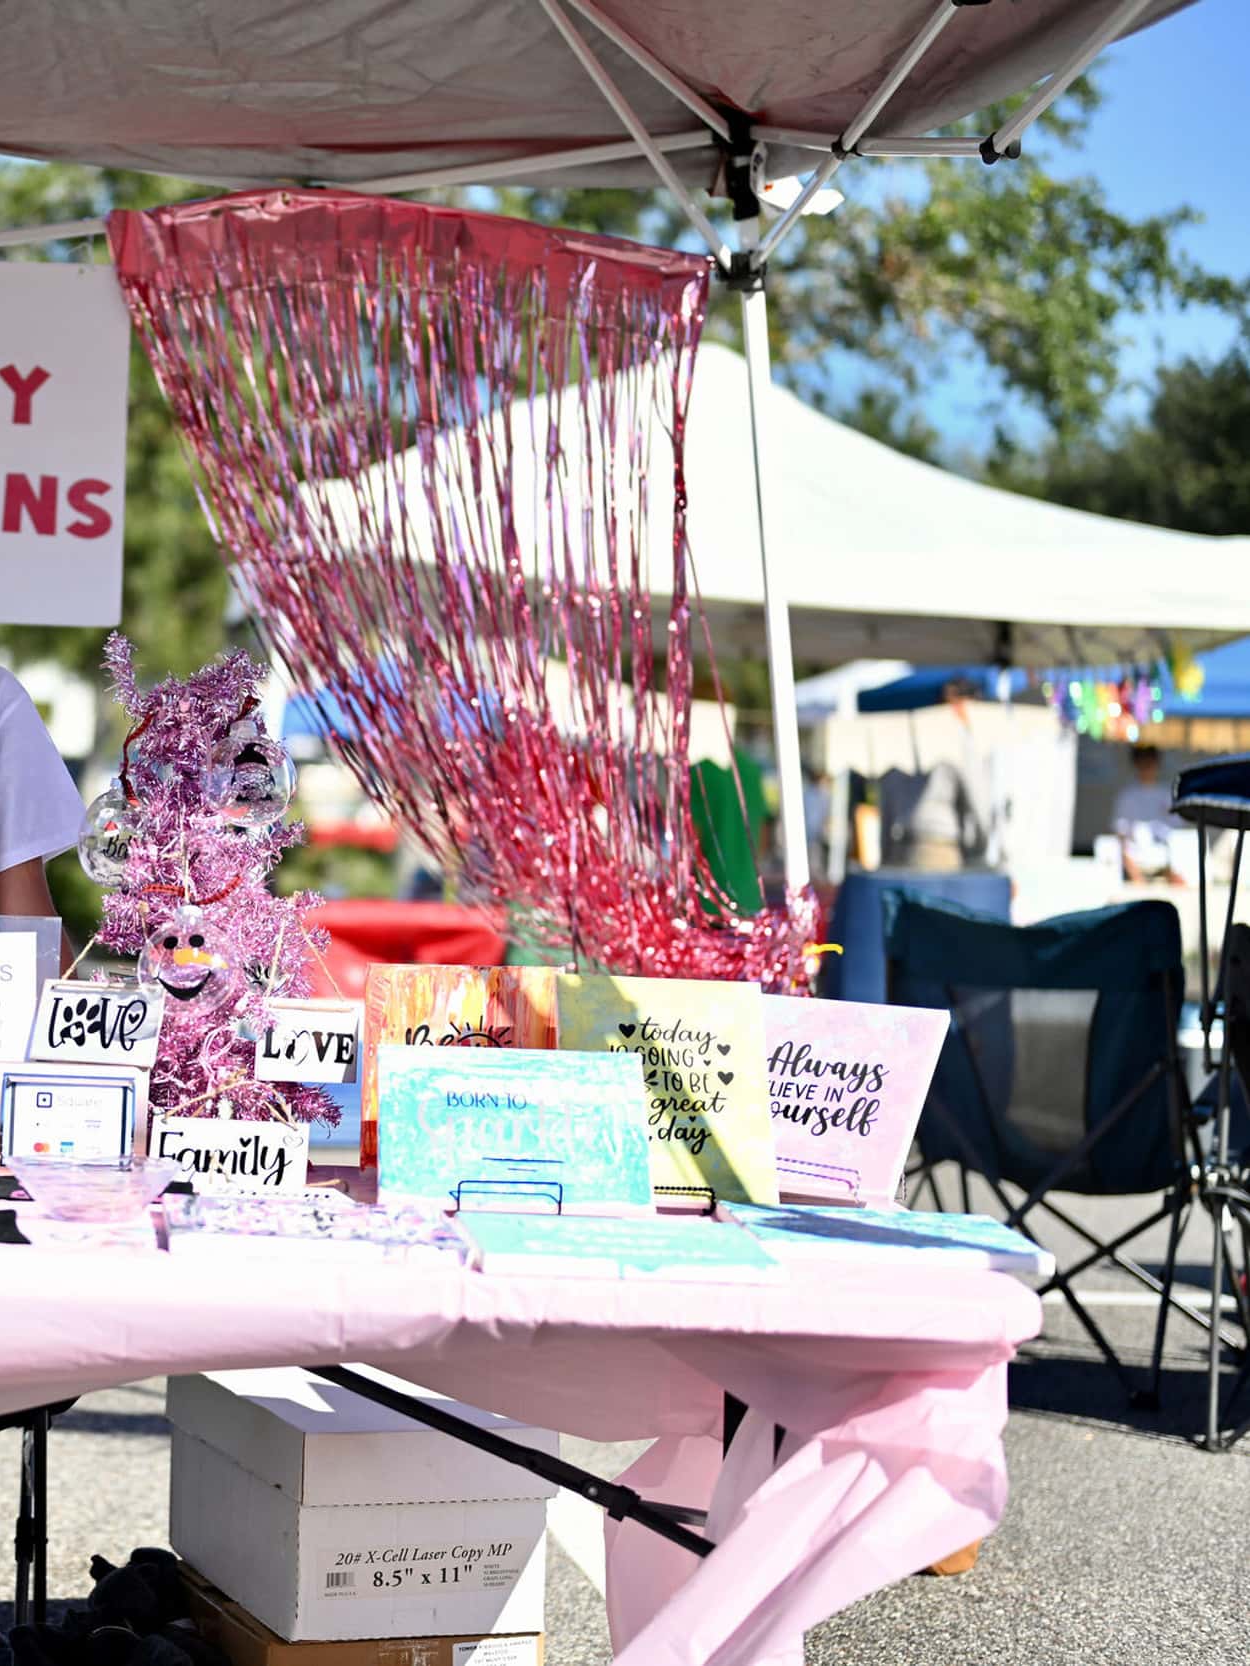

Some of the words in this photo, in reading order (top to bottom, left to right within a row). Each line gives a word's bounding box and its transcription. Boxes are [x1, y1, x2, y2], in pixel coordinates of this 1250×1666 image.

[640, 1016, 717, 1055] today
[767, 1041, 889, 1093] Always
[662, 1071, 683, 1093] TO
[768, 1079, 818, 1100] LIEVE
[825, 1086, 845, 1102] IN
[446, 1091, 499, 1108] BORN
[507, 1092, 528, 1110] TO
[649, 1091, 726, 1124] great
[658, 1115, 712, 1154] day
[159, 1132, 293, 1186] Family
[335, 1552, 361, 1566] 20#
[365, 1549, 408, 1565] X-Cell
[412, 1548, 447, 1561] Laser
[451, 1545, 484, 1563] Copy
[487, 1543, 512, 1557] MP
[373, 1567, 414, 1588] 8.5"
[421, 1573, 431, 1585] x
[439, 1564, 472, 1584] 11"
